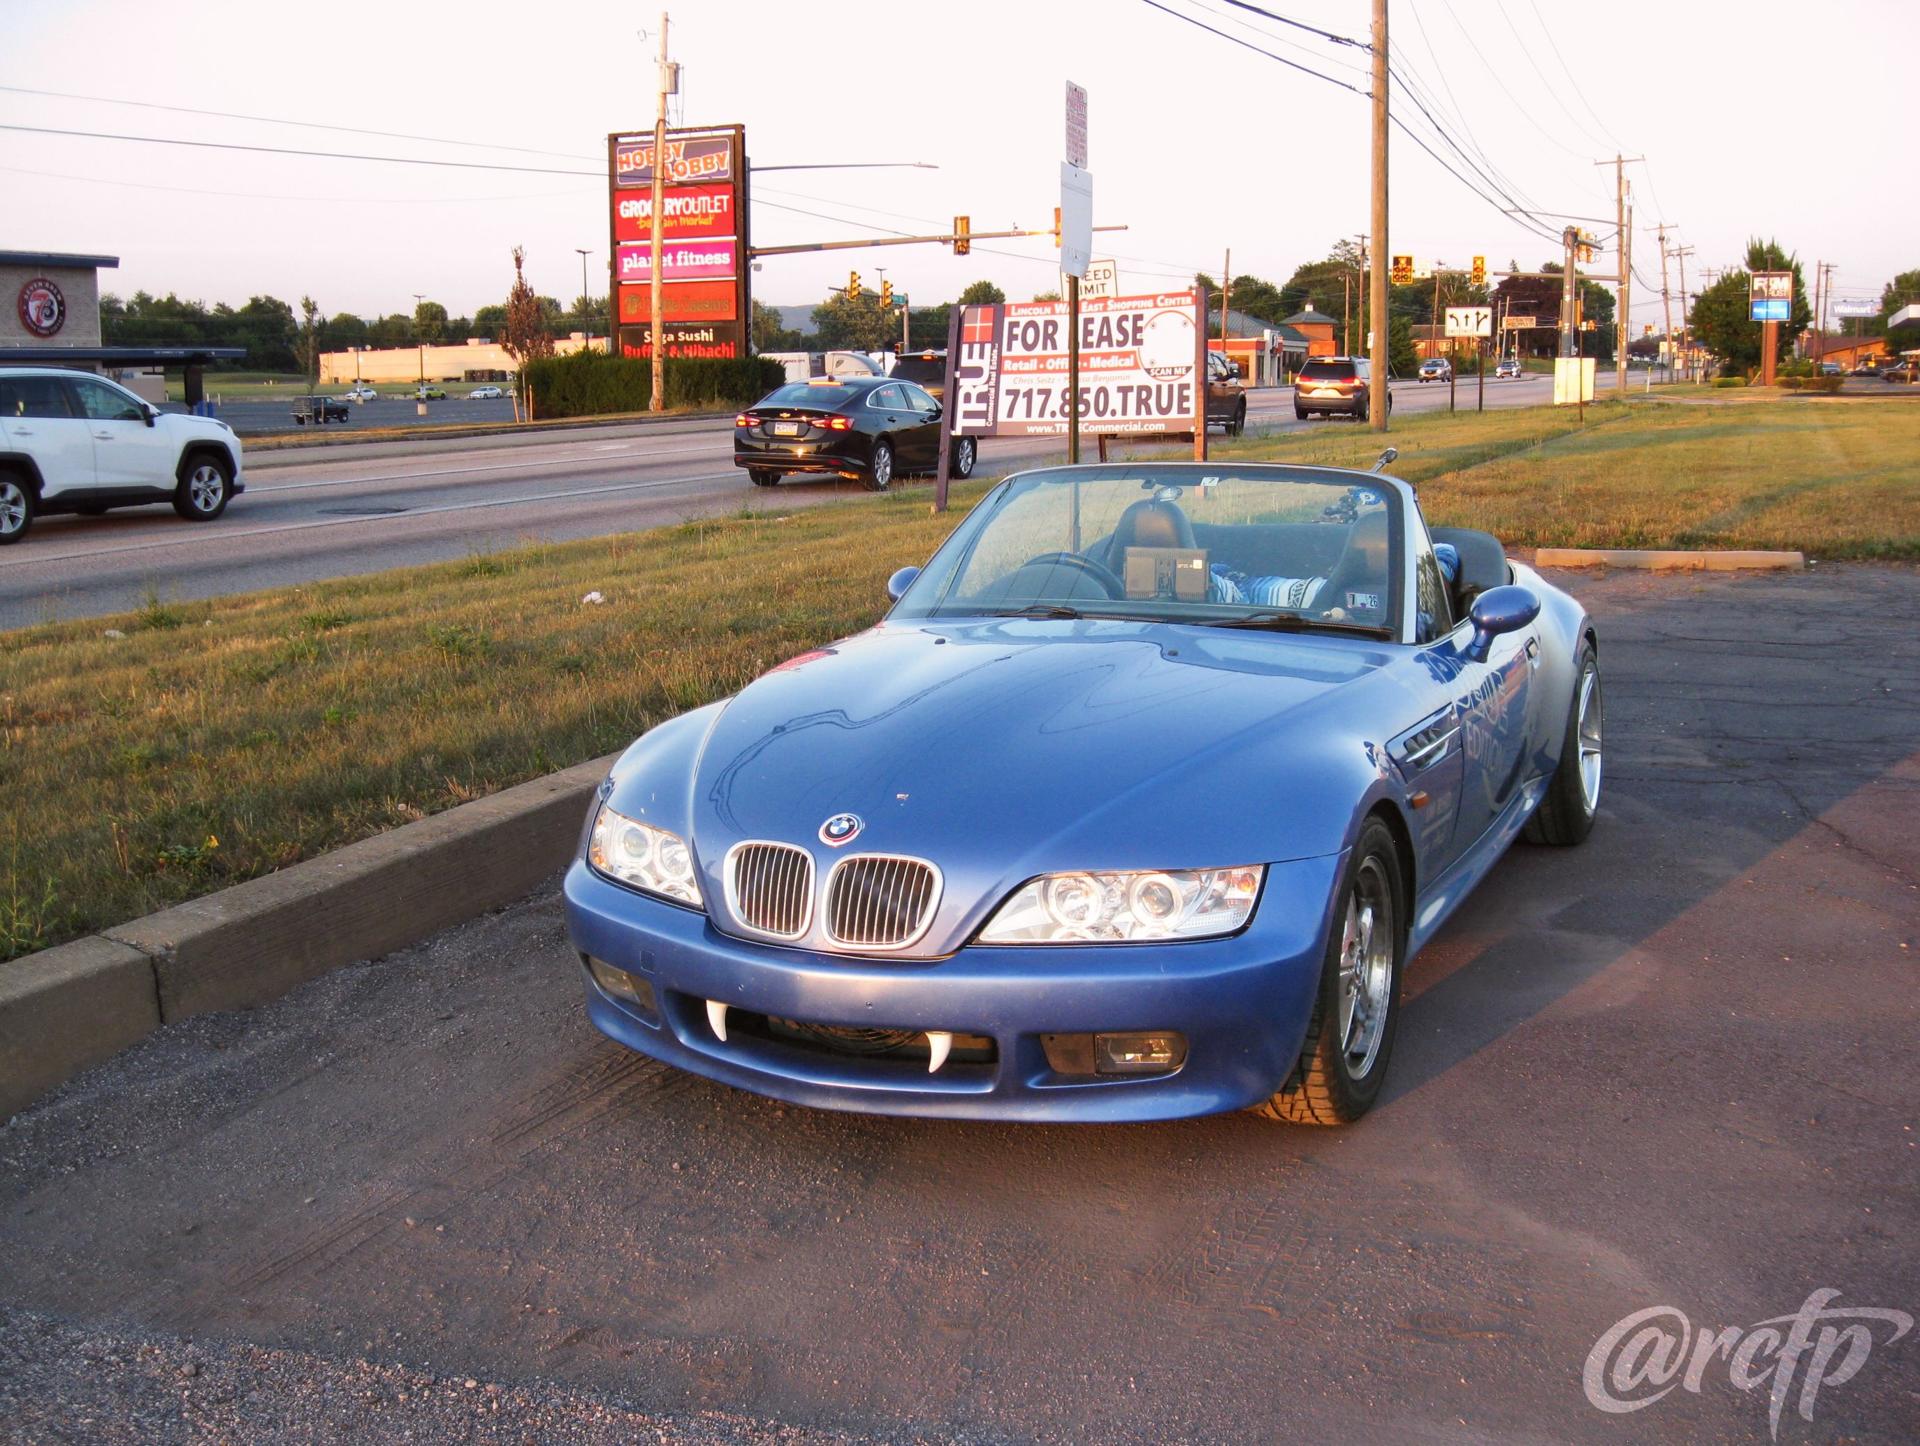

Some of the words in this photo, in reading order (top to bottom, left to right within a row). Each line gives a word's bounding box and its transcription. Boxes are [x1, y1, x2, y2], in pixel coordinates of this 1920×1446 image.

[676, 250, 731, 267] fitness
[1066, 268, 1112, 284] SEED
[1078, 282, 1107, 296] IMIT
[1081, 301, 1104, 312] EAST
[1107, 298, 1153, 311] SHOPPING
[1156, 295, 1192, 307] CENTER
[643, 330, 675, 345] Sga
[677, 328, 714, 342] Sushi
[1006, 319, 1059, 352] FOR
[1069, 313, 1144, 350] EASE
[1003, 359, 1037, 371] Retail
[1089, 355, 1134, 368] Medical
[1150, 367, 1173, 377] SCAN
[1174, 366, 1187, 376] ME
[954, 343, 992, 436] TRUE
[1026, 423, 1165, 434] www.TRECommercial.com
